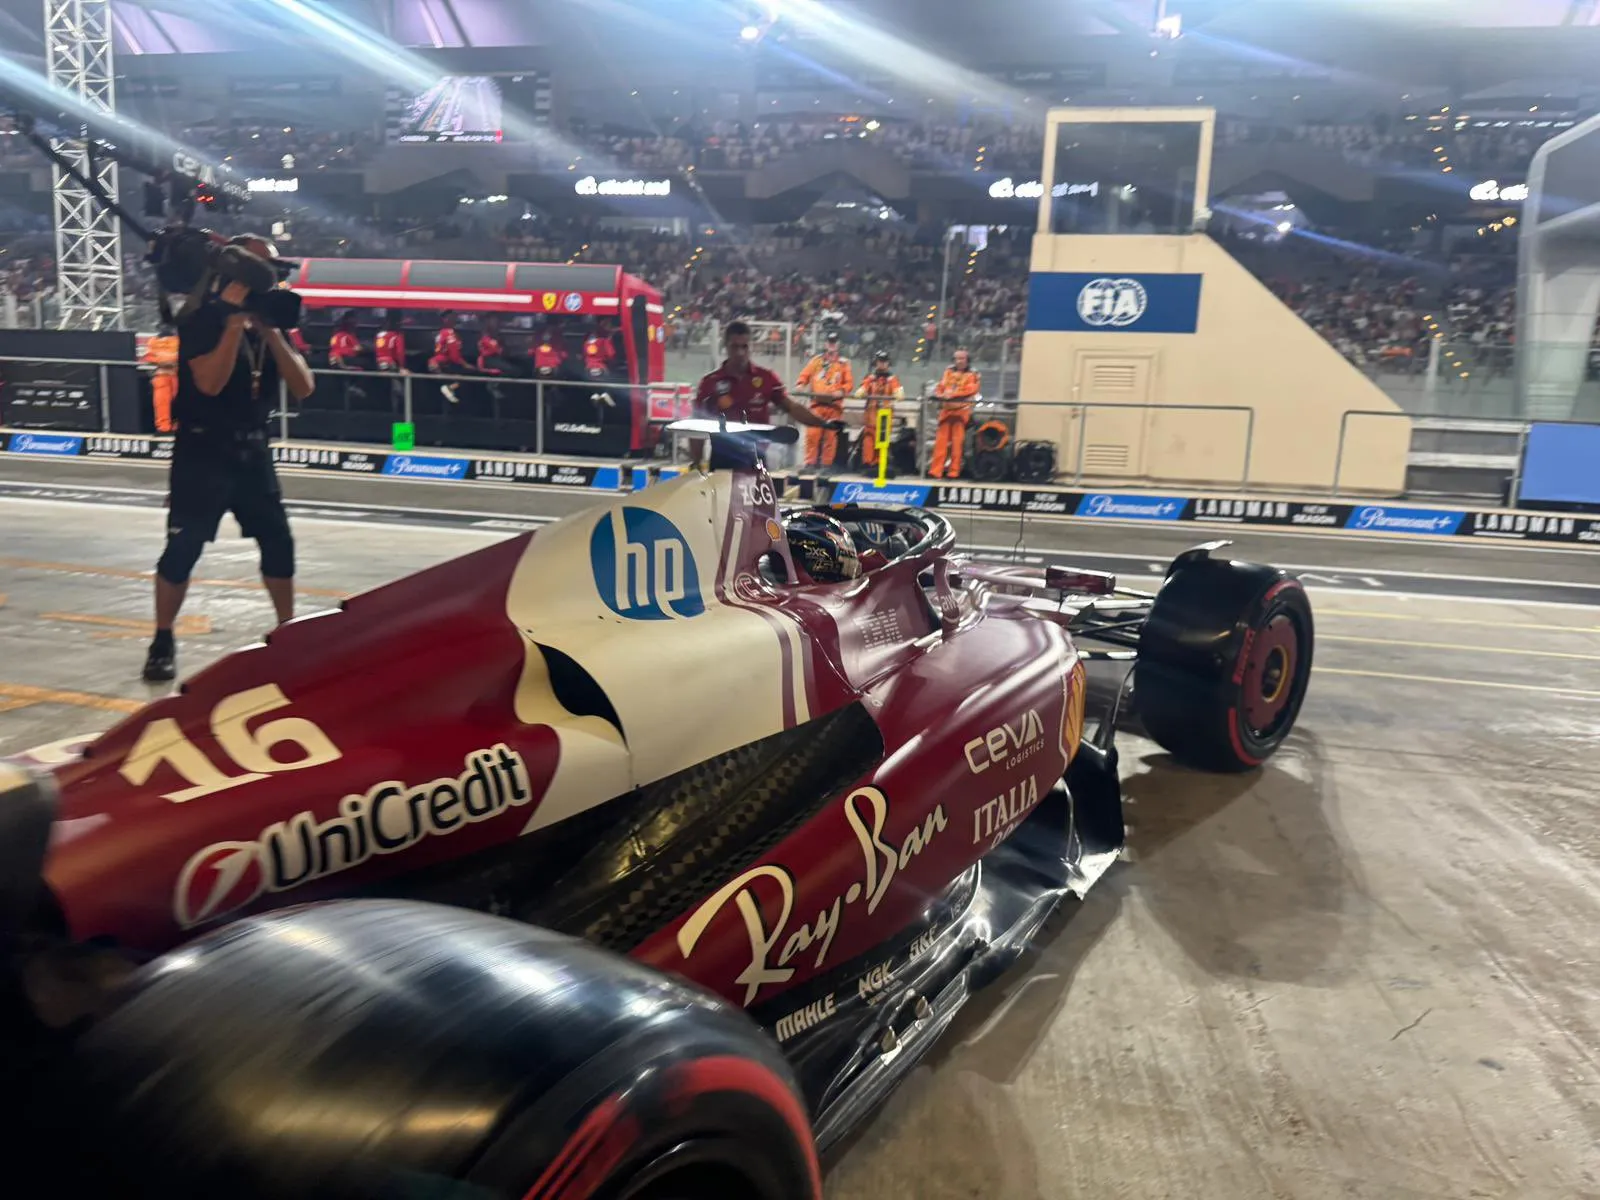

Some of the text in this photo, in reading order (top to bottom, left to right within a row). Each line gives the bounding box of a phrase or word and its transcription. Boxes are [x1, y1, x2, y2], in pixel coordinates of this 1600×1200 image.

[1081, 287, 1138, 316] FIA
[271, 448, 339, 465] LANDMAN
[475, 460, 548, 478] LANDMAN
[840, 483, 920, 504] Paramount+
[938, 486, 1023, 505] LANDMAN
[1085, 494, 1176, 516] Paramount+
[1025, 501, 1066, 512] SEASON
[1195, 498, 1288, 518] LANDMAN
[1292, 513, 1337, 525] SEASON
[1356, 507, 1453, 531] Paramount+
[1473, 512, 1575, 535] LANDMAN
[610, 506, 687, 619] hp
[118, 682, 343, 803] 16
[1006, 738, 1045, 770] LOGISTICS
[267, 745, 530, 890] UniCredit
[973, 774, 1038, 845] ITALIA
[858, 959, 895, 998] NGK
[775, 992, 836, 1042] MAHLE
